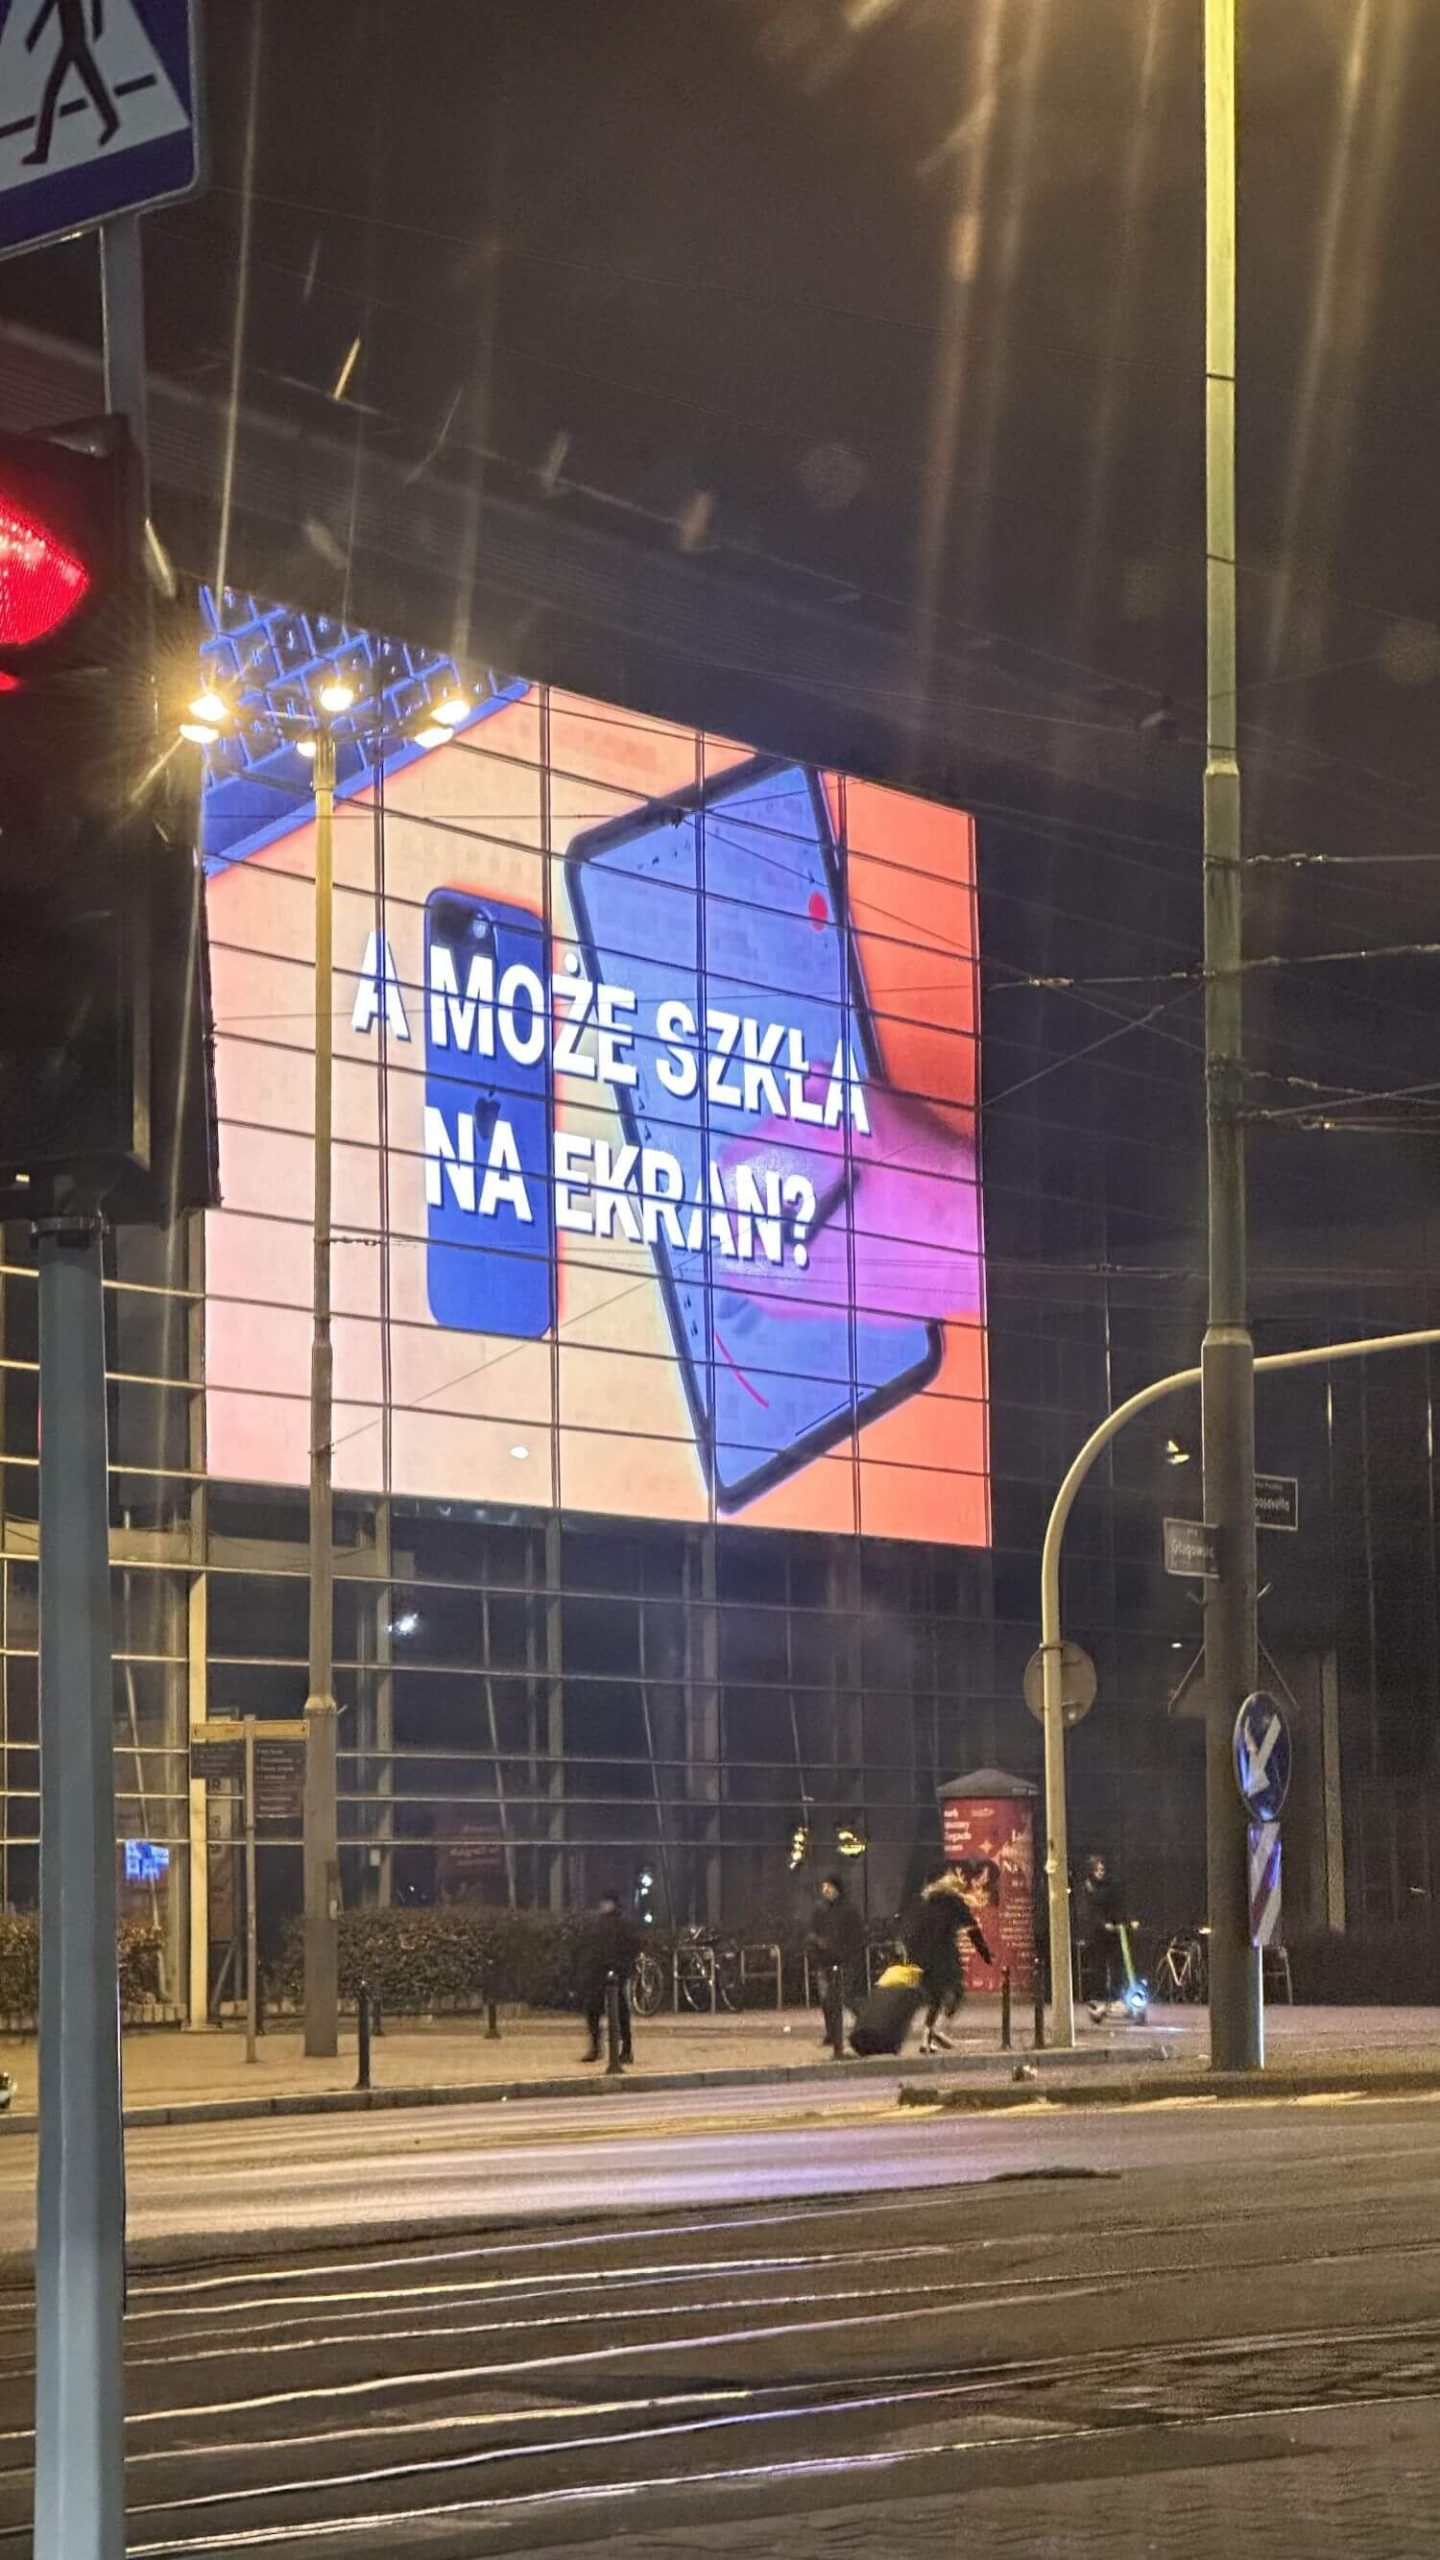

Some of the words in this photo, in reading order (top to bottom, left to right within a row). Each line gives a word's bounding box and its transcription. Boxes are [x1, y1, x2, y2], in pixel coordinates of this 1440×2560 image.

[351, 932, 409, 1040] A
[430, 944, 637, 1085] MOŻE
[655, 1000, 871, 1134] SZKŁA
[424, 1105, 533, 1222] NA
[553, 1131, 816, 1268] EKRAN?
